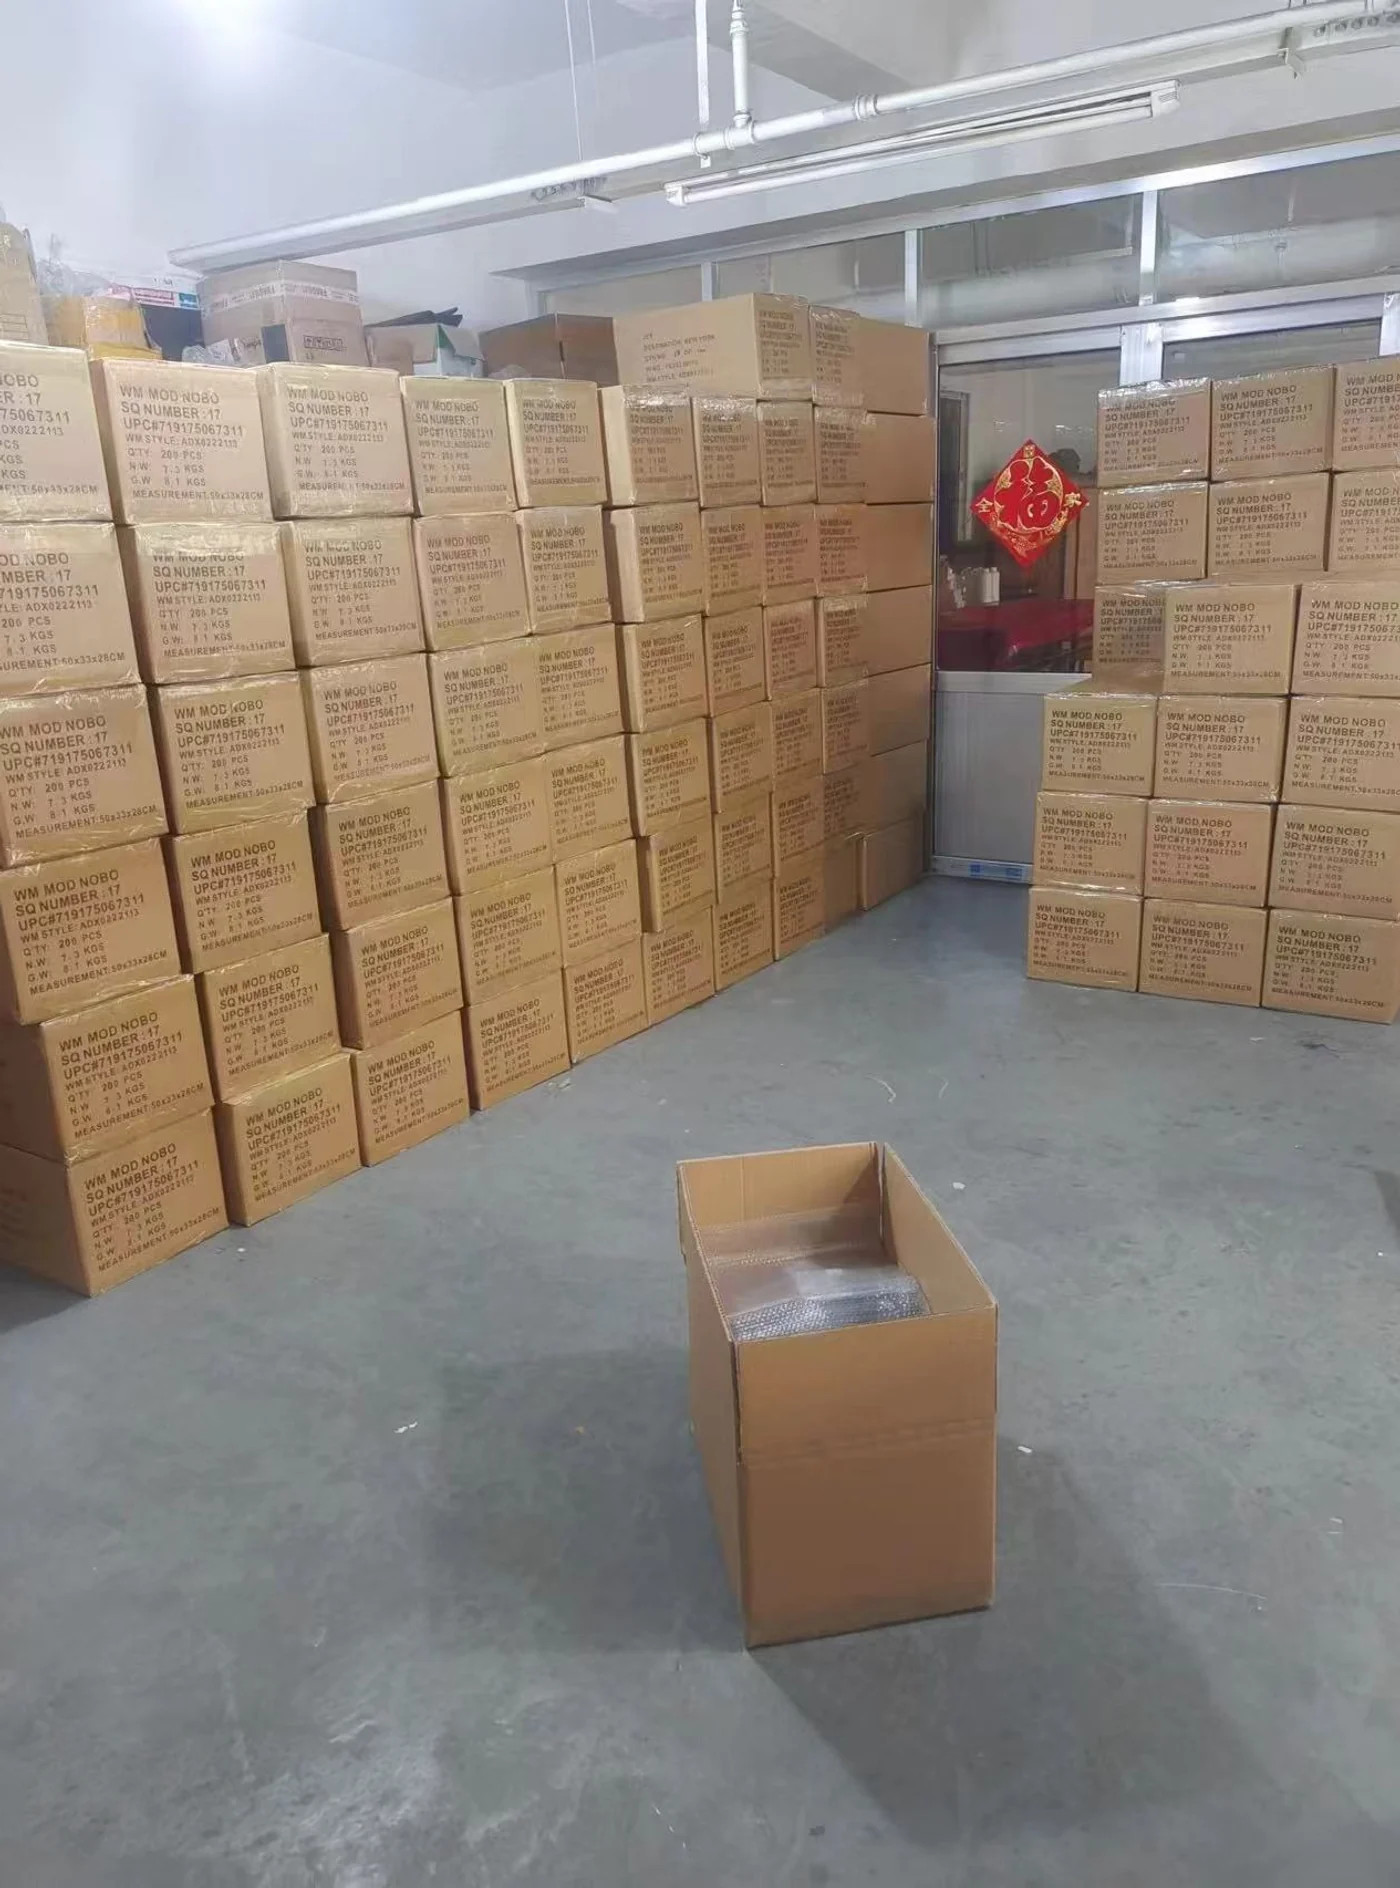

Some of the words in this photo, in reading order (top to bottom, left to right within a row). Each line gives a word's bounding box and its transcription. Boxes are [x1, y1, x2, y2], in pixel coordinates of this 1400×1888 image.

[147, 387, 178, 402] MOD
[181, 390, 220, 405] NOBO
[120, 400, 141, 415] SQ
[199, 703, 227, 716] MOD
[214, 847, 241, 862] MOD
[243, 839, 276, 856] NOBO
[191, 869, 209, 882] SQ
[13, 886, 38, 901] WM
[43, 878, 76, 895] MOD
[78, 868, 119, 888] NOBO
[15, 903, 36, 917] SQ
[20, 932, 39, 943] WM
[81, 930, 102, 942] PCS
[83, 942, 105, 954] KGS
[86, 954, 107, 966] KGS
[58, 1035, 82, 1052] WM
[86, 1025, 117, 1043] MOD
[120, 1011, 158, 1032] NOBO
[60, 1051, 80, 1066] SQ
[123, 1070, 143, 1083] PCS
[65, 1079, 83, 1091] WM
[84, 1173, 106, 1190] WM
[110, 1159, 138, 1179] MOD
[140, 1142, 176, 1166] NOBO
[85, 1189, 104, 1204] SQ
